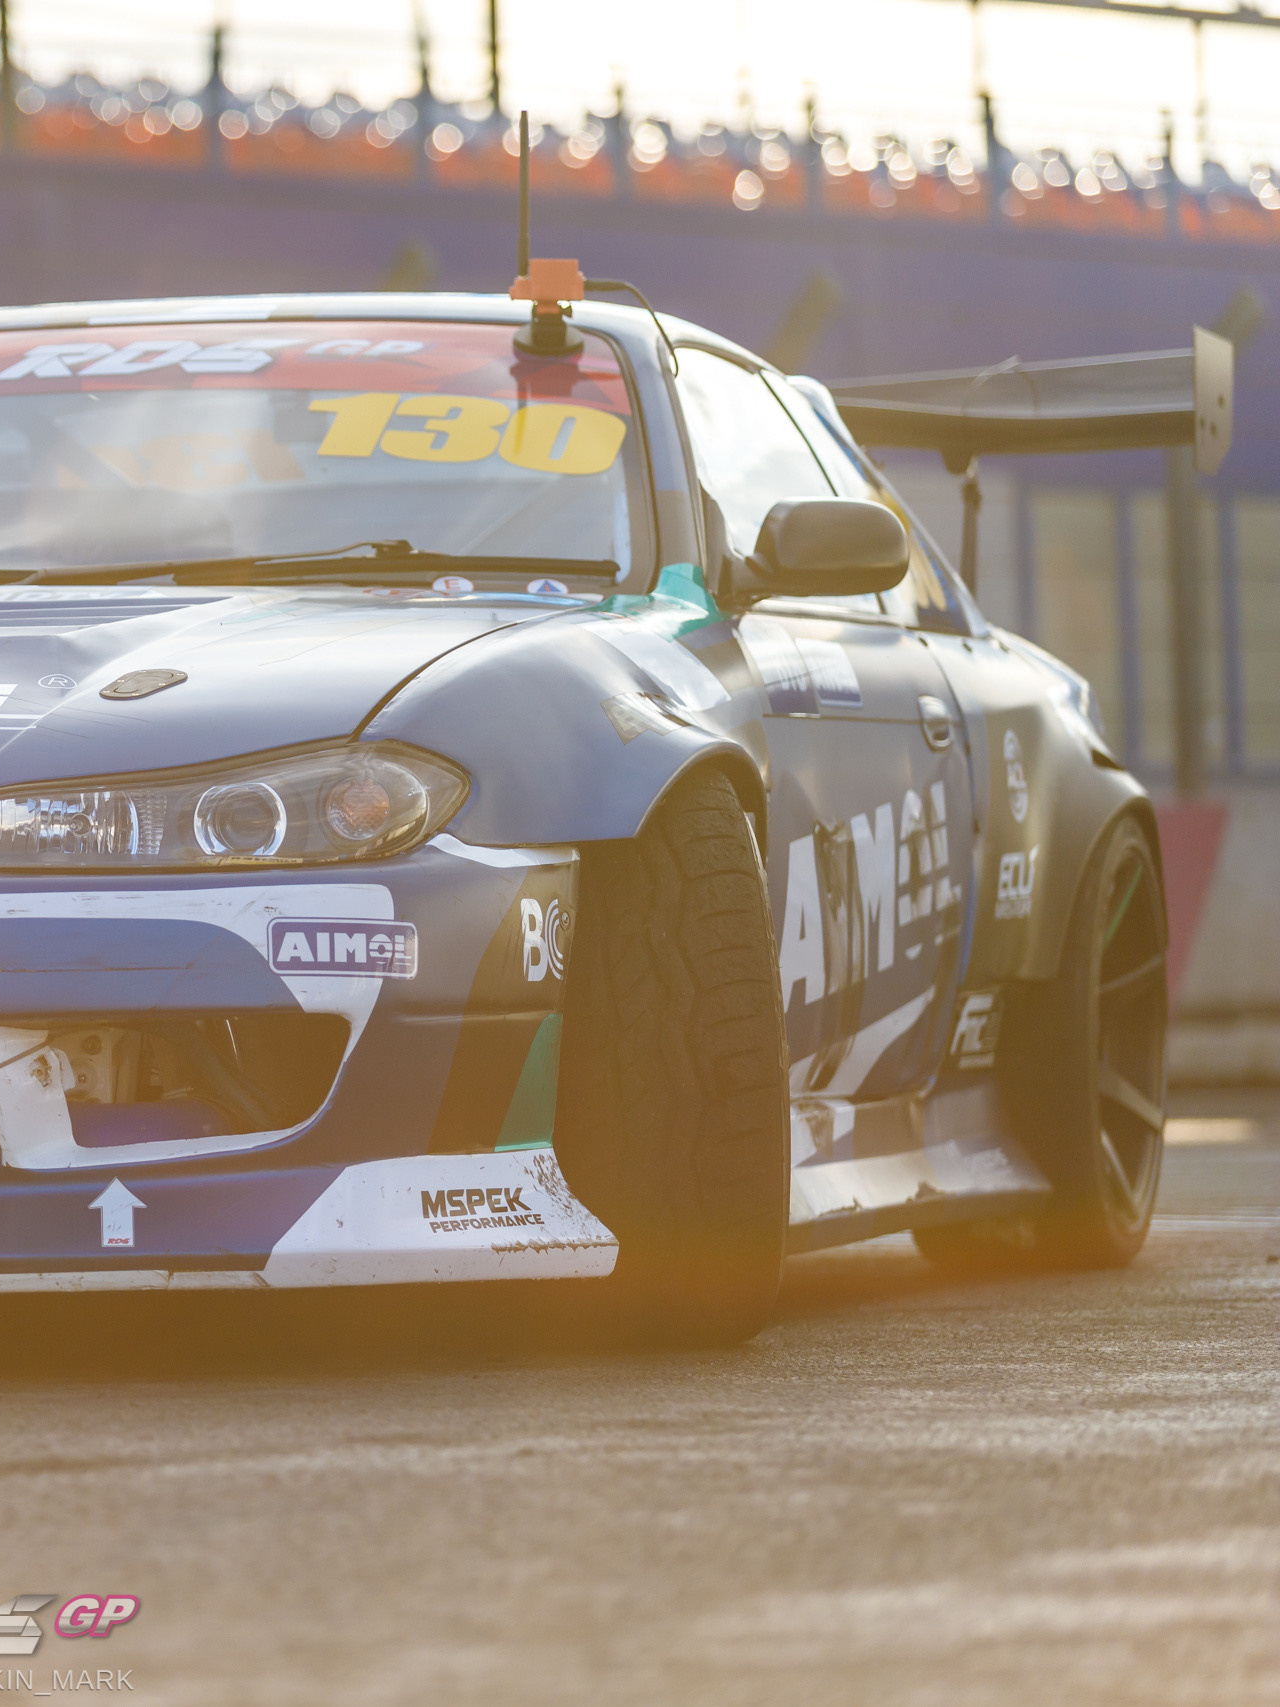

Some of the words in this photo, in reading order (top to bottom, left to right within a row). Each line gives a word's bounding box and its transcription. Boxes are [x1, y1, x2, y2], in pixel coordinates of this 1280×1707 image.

[307, 392, 628, 476] 130
[276, 931, 412, 966] AIMOL
[420, 1187, 533, 1219] MSPEK
[429, 1213, 545, 1234] PERFORMANCE
